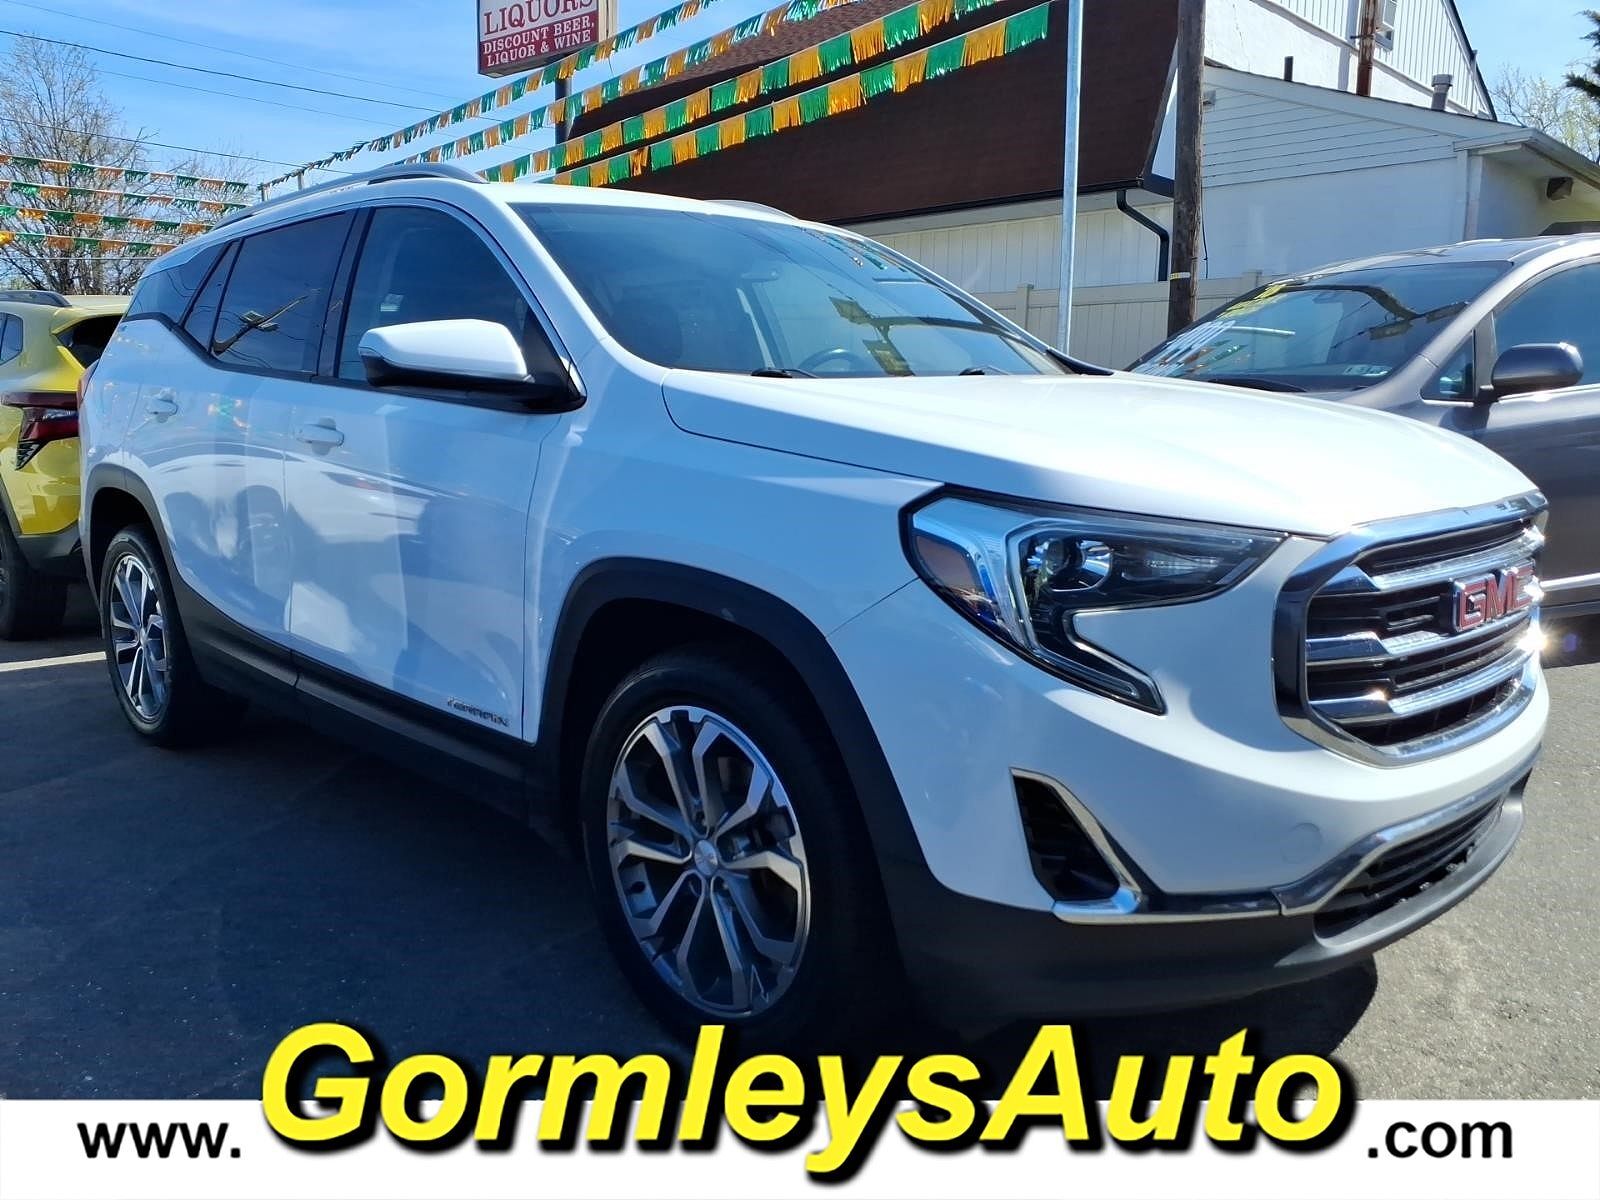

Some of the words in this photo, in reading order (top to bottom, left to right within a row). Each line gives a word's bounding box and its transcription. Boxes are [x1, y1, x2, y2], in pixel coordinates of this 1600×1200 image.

[483, 26, 549, 54] DISCOUNT
[554, 15, 595, 36] BEER,
[487, 44, 536, 67] LIQUOR
[540, 41, 550, 53] &
[554, 29, 591, 50] WINE
[1453, 561, 1539, 632] GMC
